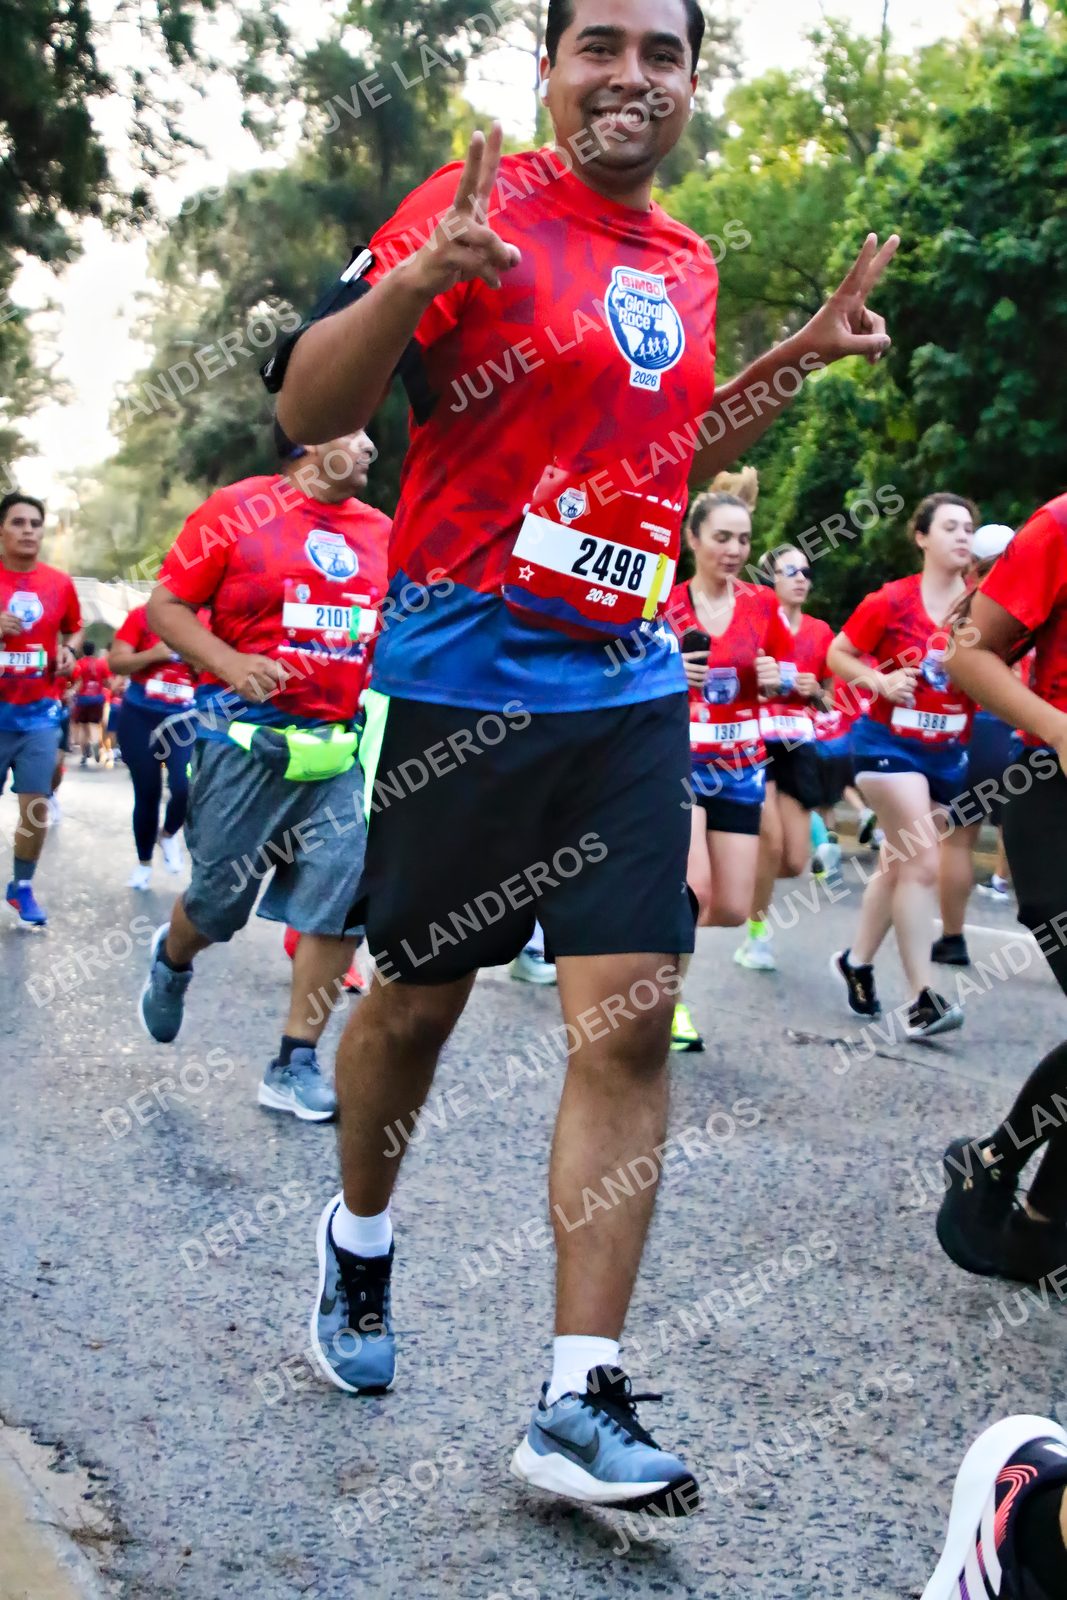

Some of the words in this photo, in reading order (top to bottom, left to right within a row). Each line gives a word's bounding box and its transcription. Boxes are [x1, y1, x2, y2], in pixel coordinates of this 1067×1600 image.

[624, 295, 663, 320] Global
[619, 308, 651, 330] Race
[633, 370, 658, 387] 2026
[571, 538, 646, 591] 2498
[316, 607, 350, 628] 2101
